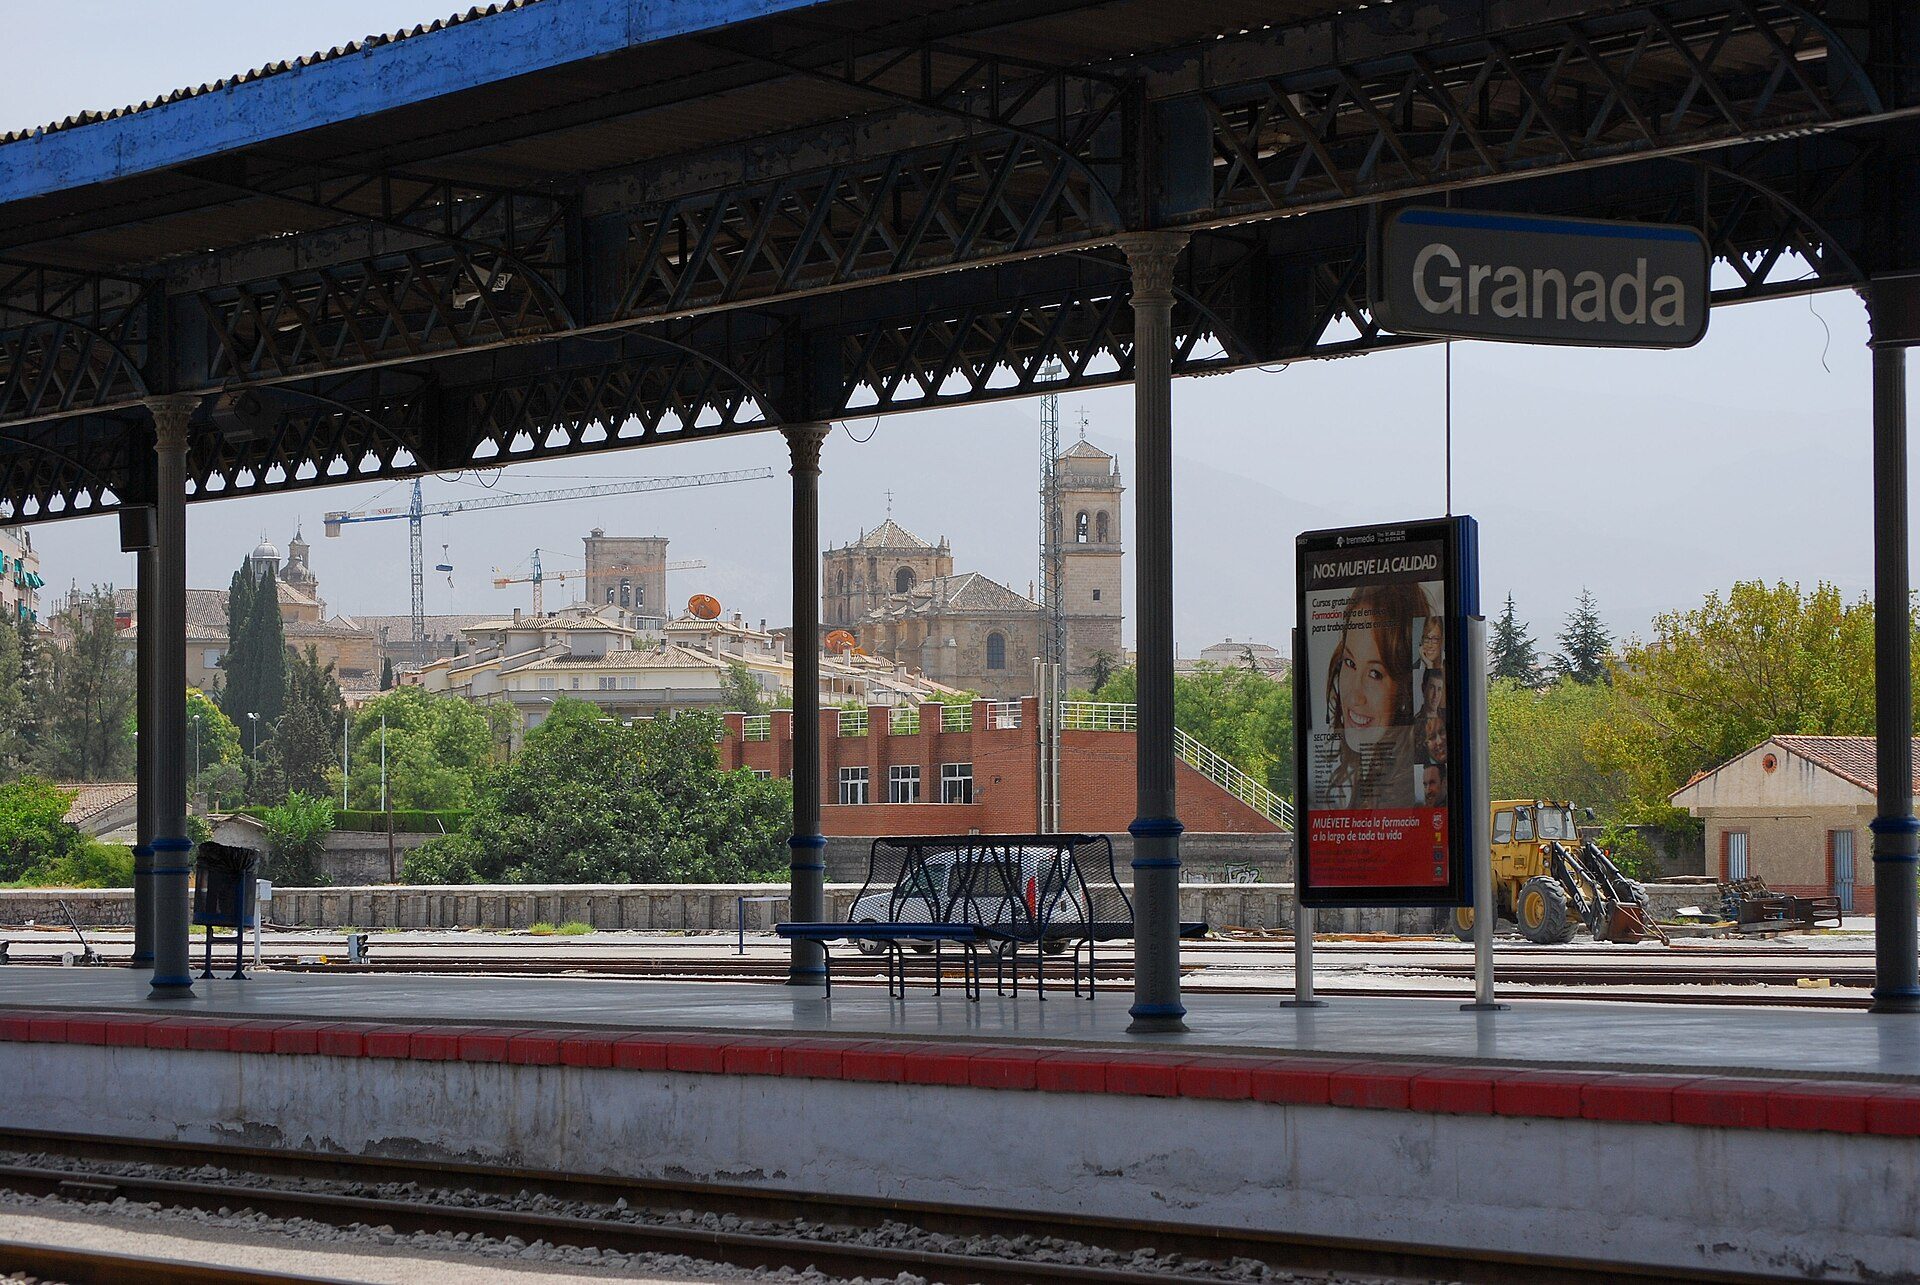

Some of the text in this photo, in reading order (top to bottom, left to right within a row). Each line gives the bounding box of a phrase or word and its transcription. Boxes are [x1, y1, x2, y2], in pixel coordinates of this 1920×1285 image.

[1412, 243, 1686, 327] Granada
[1346, 533, 1375, 544] trenmedia
[1313, 554, 1437, 579] NOS MUEVE LA CALIDAD
[1312, 598, 1331, 608] Cursos
[1312, 624, 1326, 635] para
[1312, 815, 1350, 828] MUÉVETE
[1351, 817, 1372, 827] hacia
[1373, 817, 1380, 827] la
[1381, 816, 1420, 829] formación
[1319, 831, 1326, 841] lo
[1327, 832, 1345, 844] largo
[1347, 831, 1356, 841] de
[1358, 831, 1375, 841] toda
[1377, 832, 1385, 840] tu
[1386, 830, 1402, 840] vida
[1573, 893, 1587, 914] CAT
